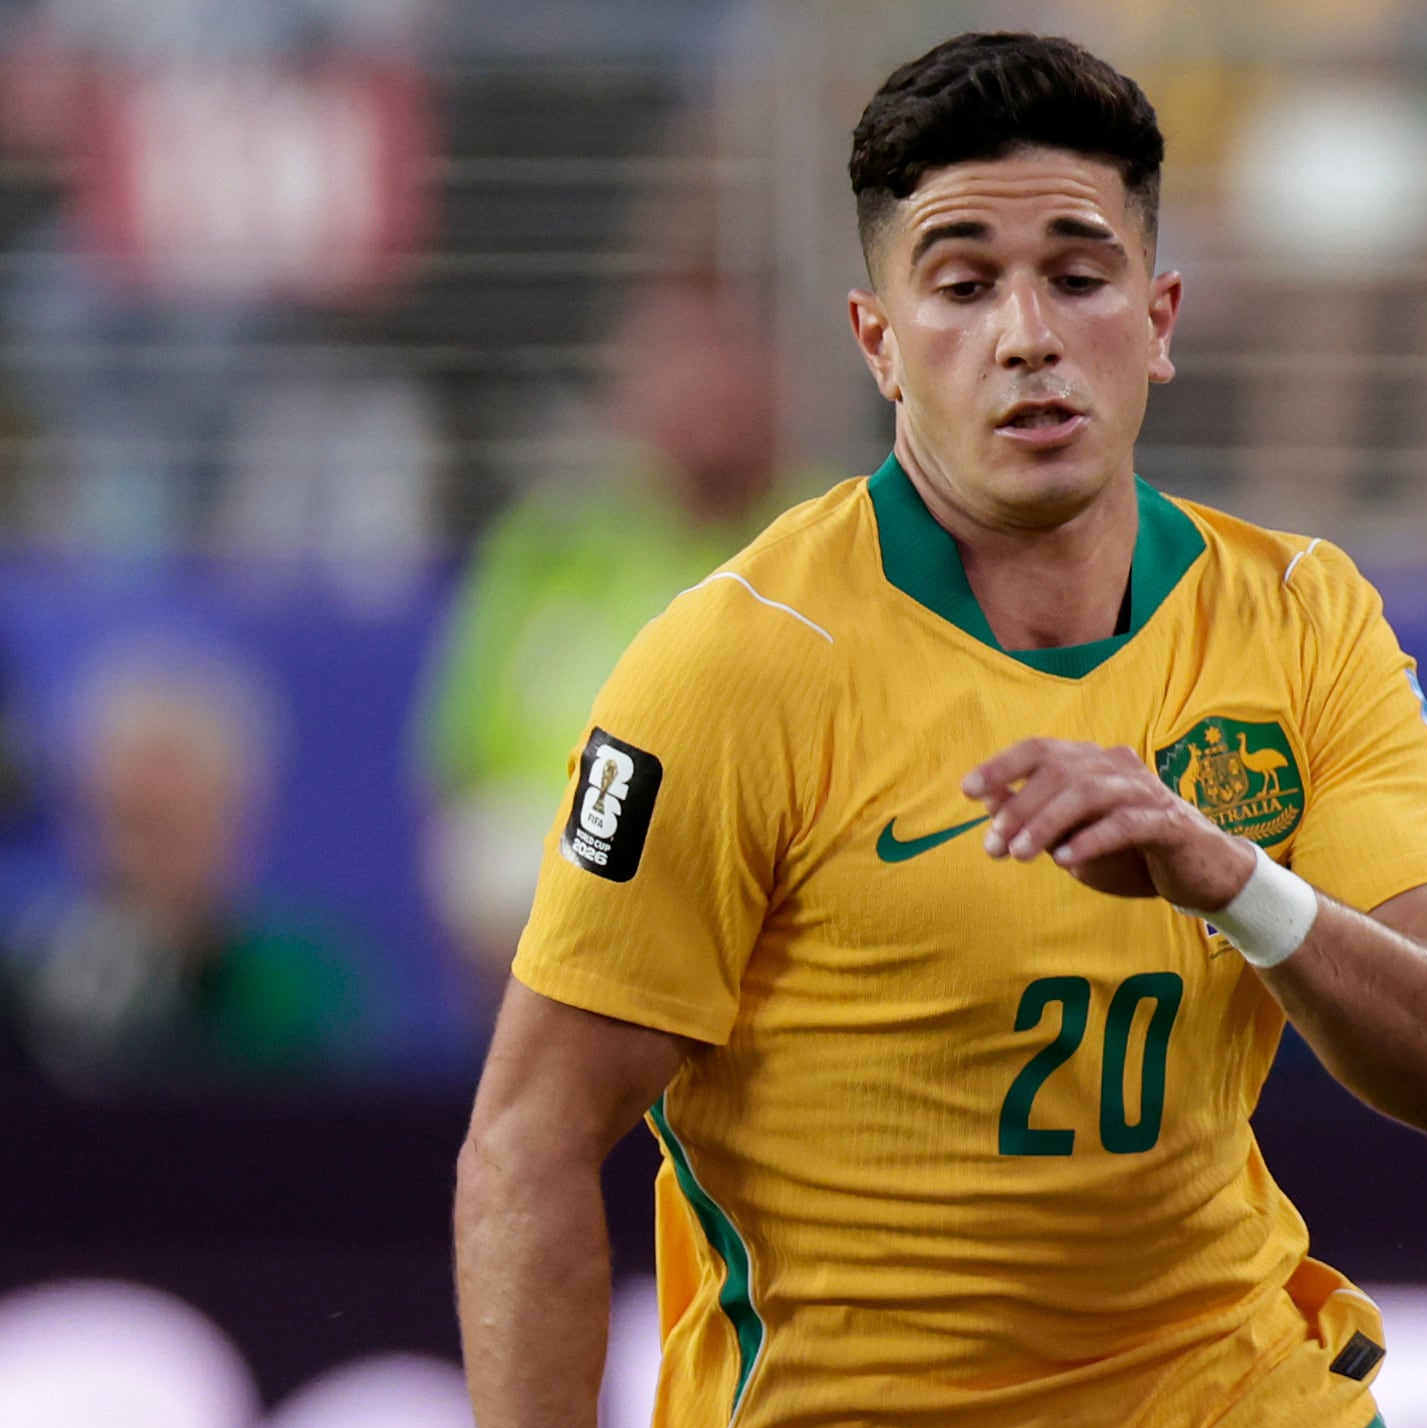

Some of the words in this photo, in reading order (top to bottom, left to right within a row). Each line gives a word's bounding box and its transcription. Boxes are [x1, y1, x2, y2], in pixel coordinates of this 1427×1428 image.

[572, 837, 608, 865] 2026
[594, 839, 612, 852] CUP
[998, 970, 1185, 1157] 20
